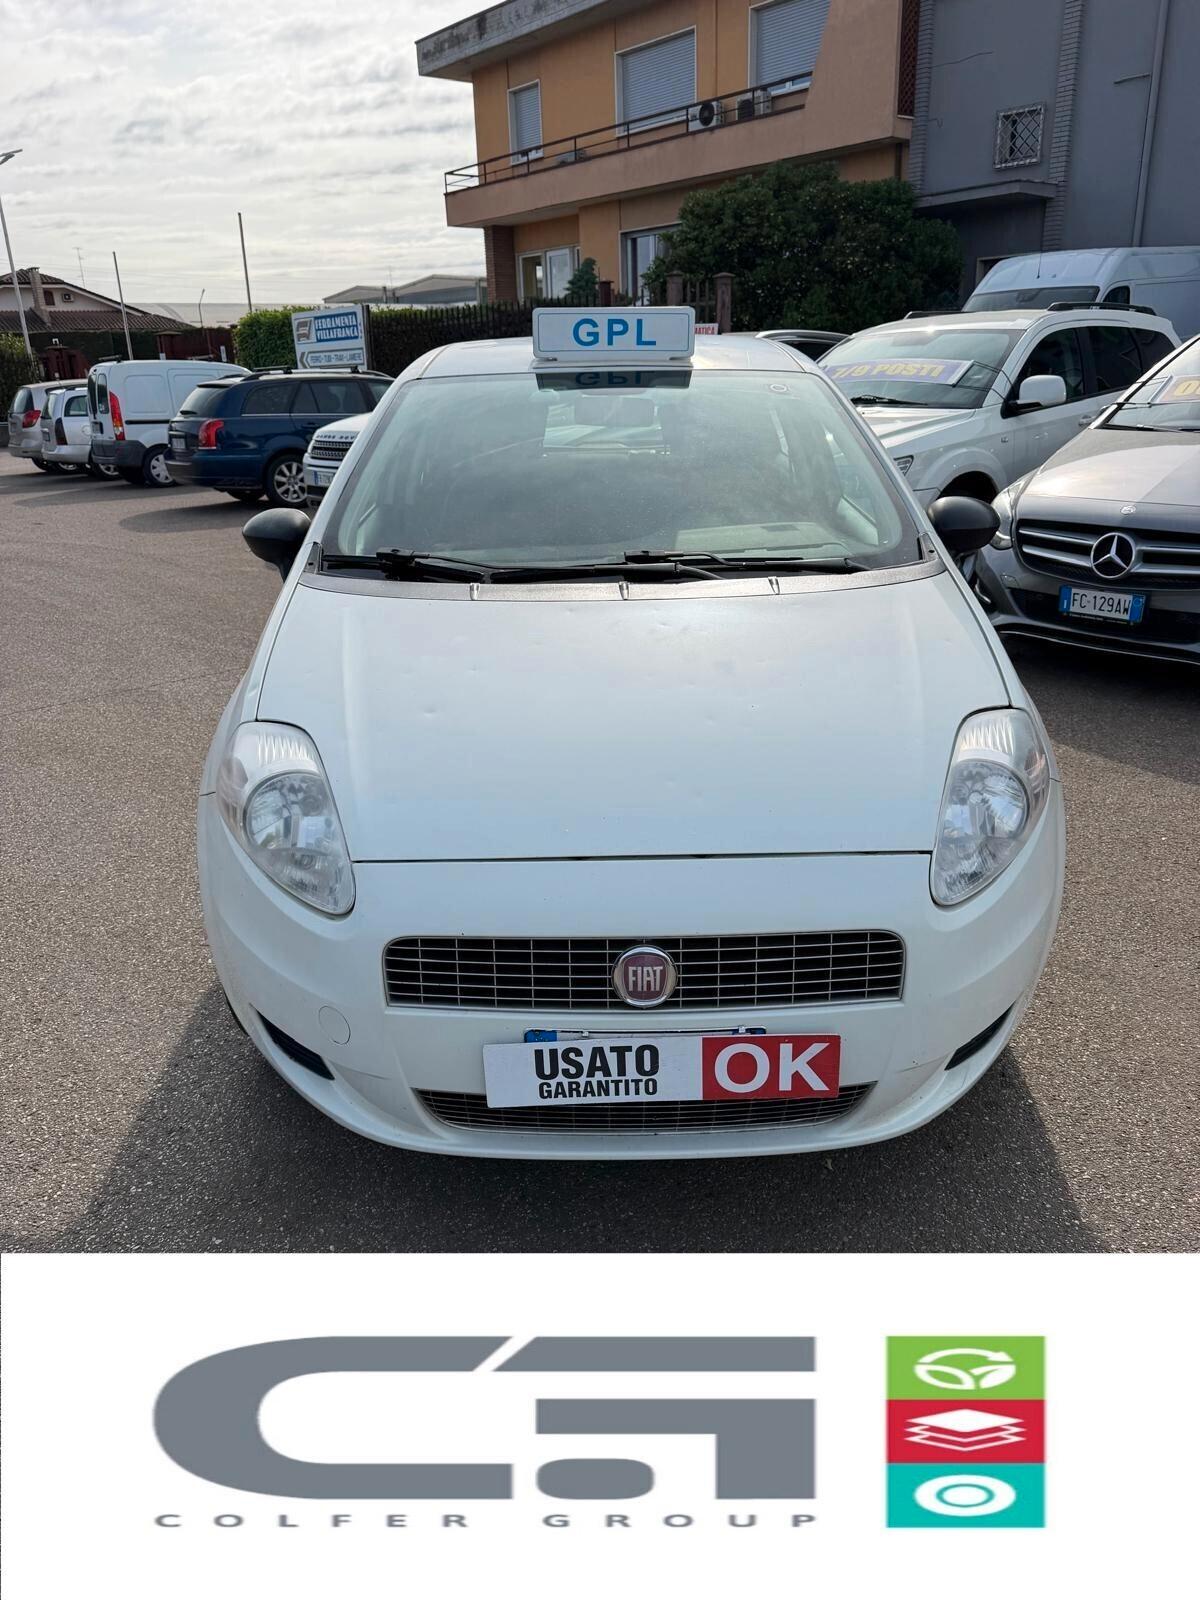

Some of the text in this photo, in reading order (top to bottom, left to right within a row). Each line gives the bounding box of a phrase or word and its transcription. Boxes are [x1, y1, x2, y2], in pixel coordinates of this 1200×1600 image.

[572, 317, 657, 347] GPL
[871, 361, 946, 378] POSTI
[628, 965, 664, 992] FIAT
[534, 1042, 831, 1094] USATO OK
[538, 1077, 659, 1100] GARANTITO
